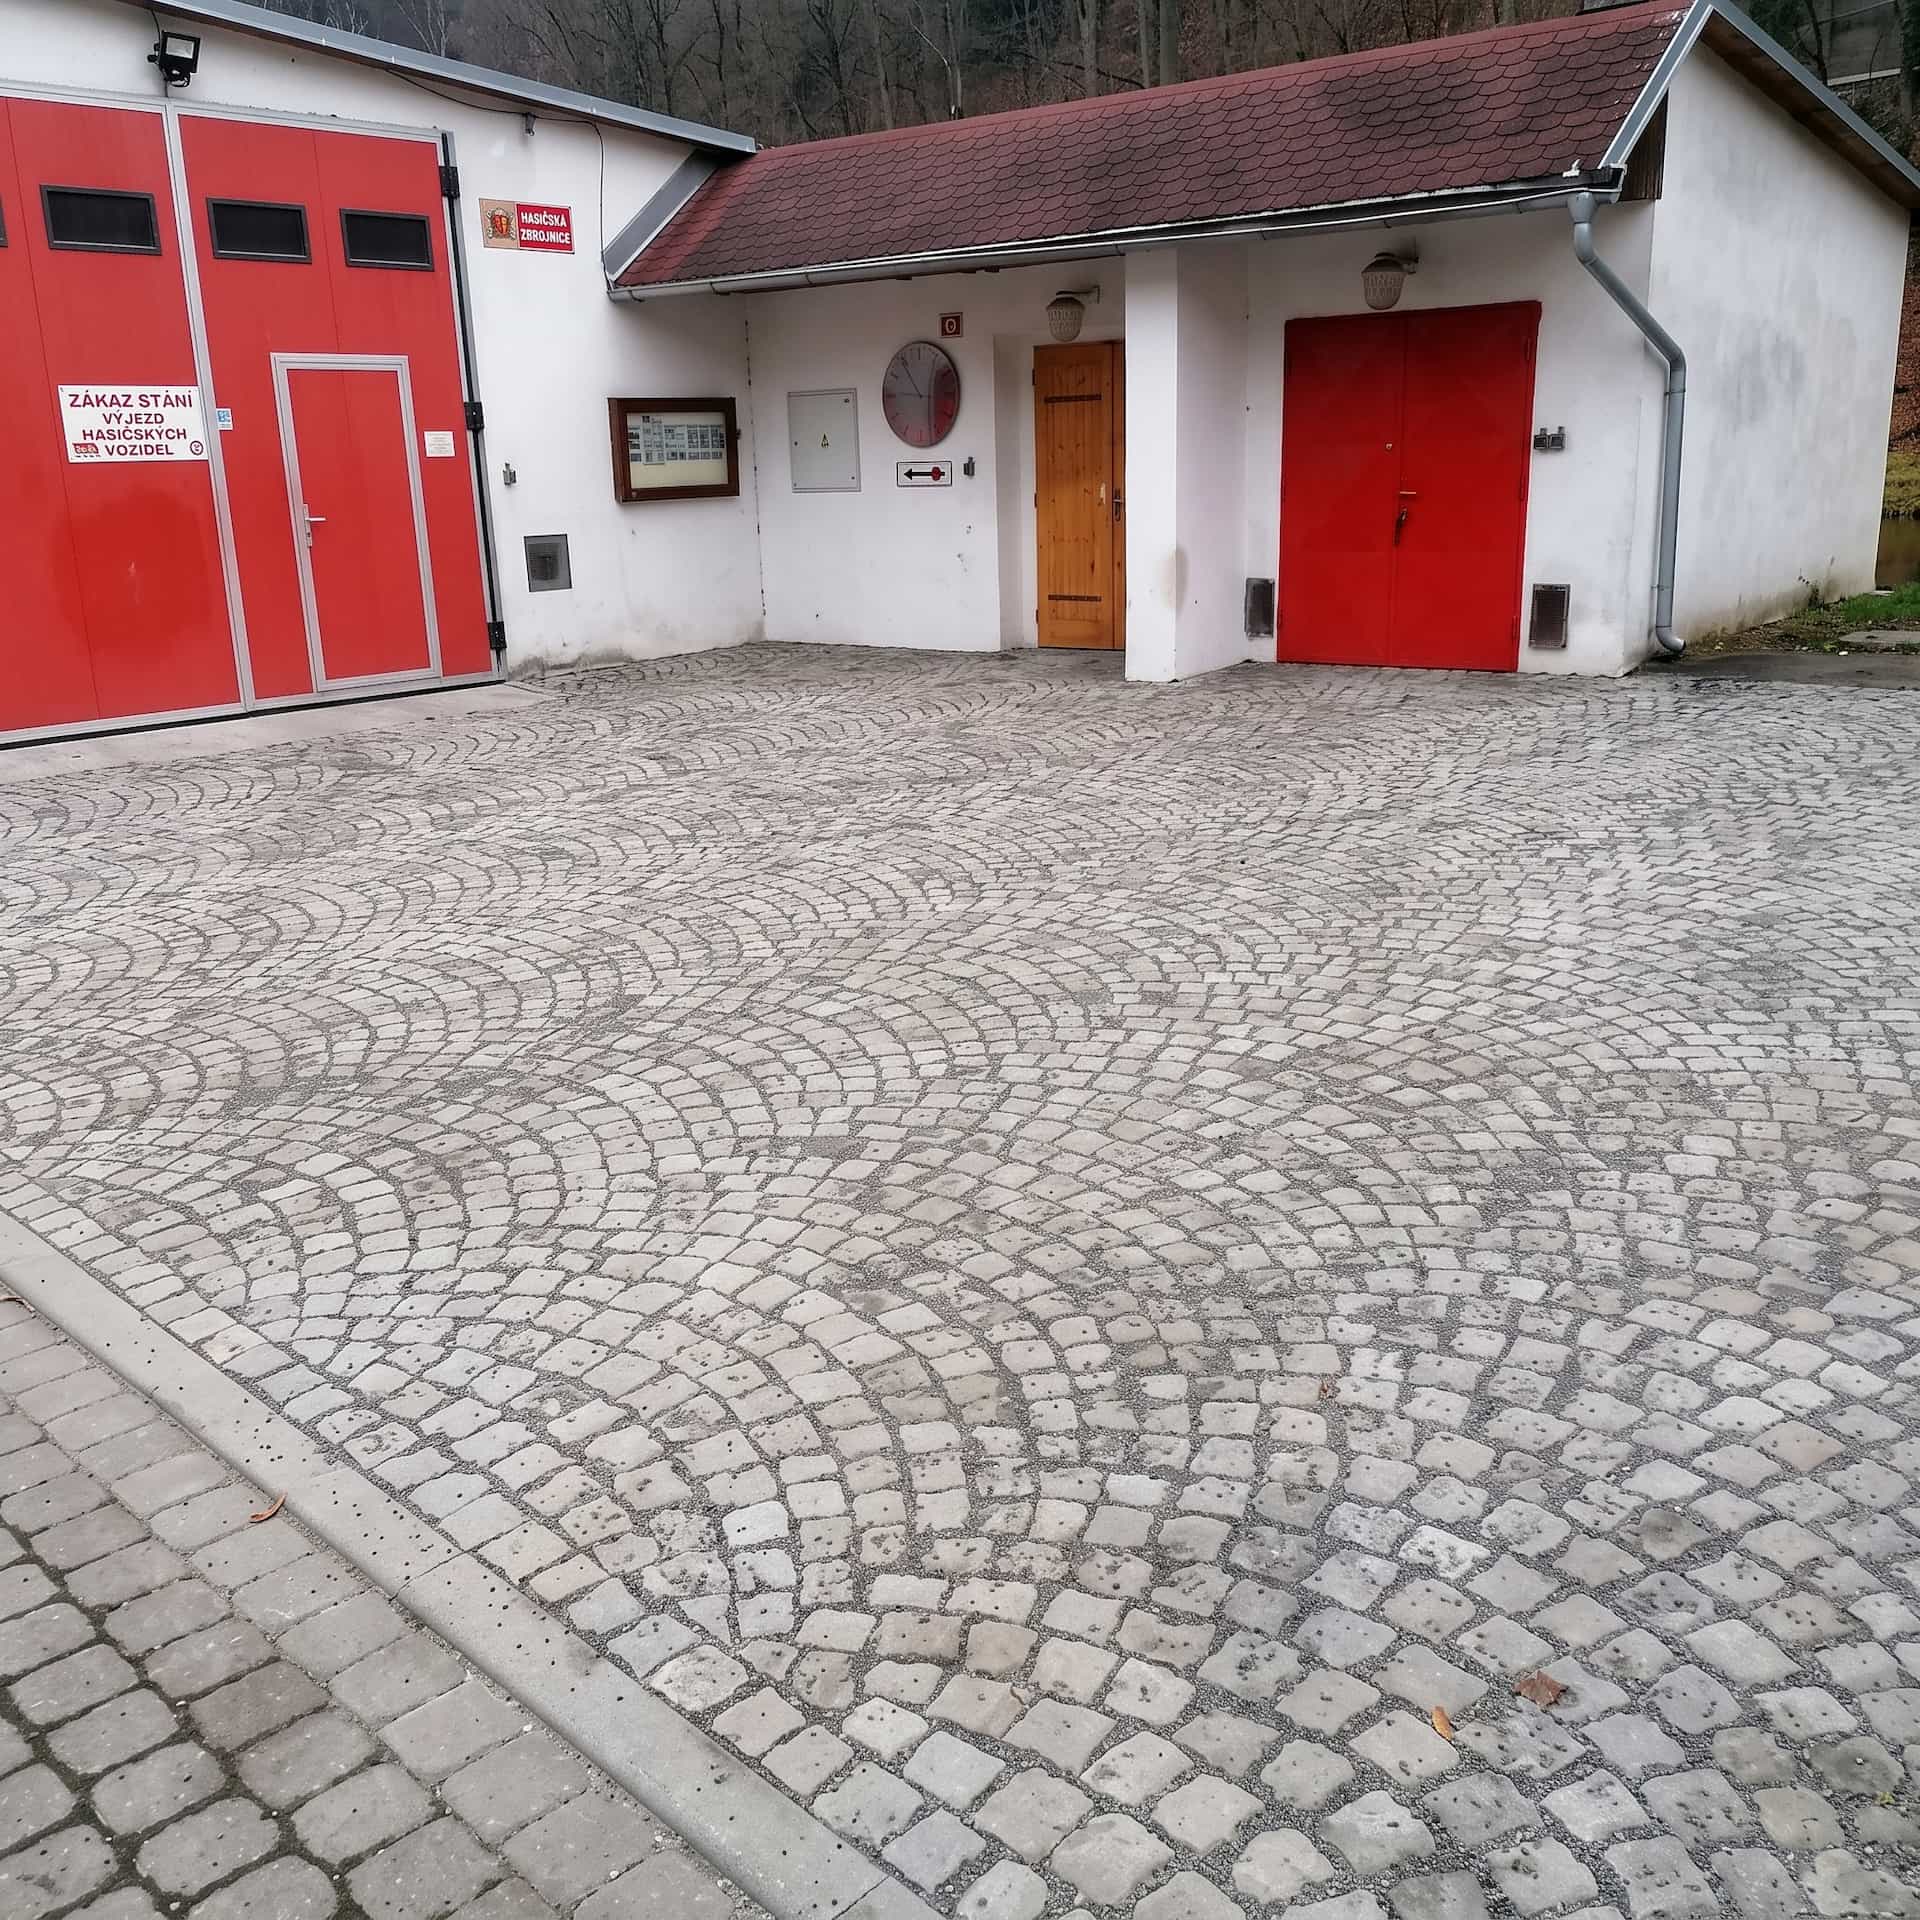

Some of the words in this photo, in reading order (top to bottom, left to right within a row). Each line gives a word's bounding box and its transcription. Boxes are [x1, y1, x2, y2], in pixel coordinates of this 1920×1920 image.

[520, 229, 571, 244] ZBROJNICE
[68, 390, 133, 408] ZÁKAZ
[139, 390, 193, 408] STÁNÍ
[102, 409, 165, 425] VÝJEZD
[82, 426, 187, 441] HASIČSKÝCH
[105, 444, 174, 457] VOZIDEL
